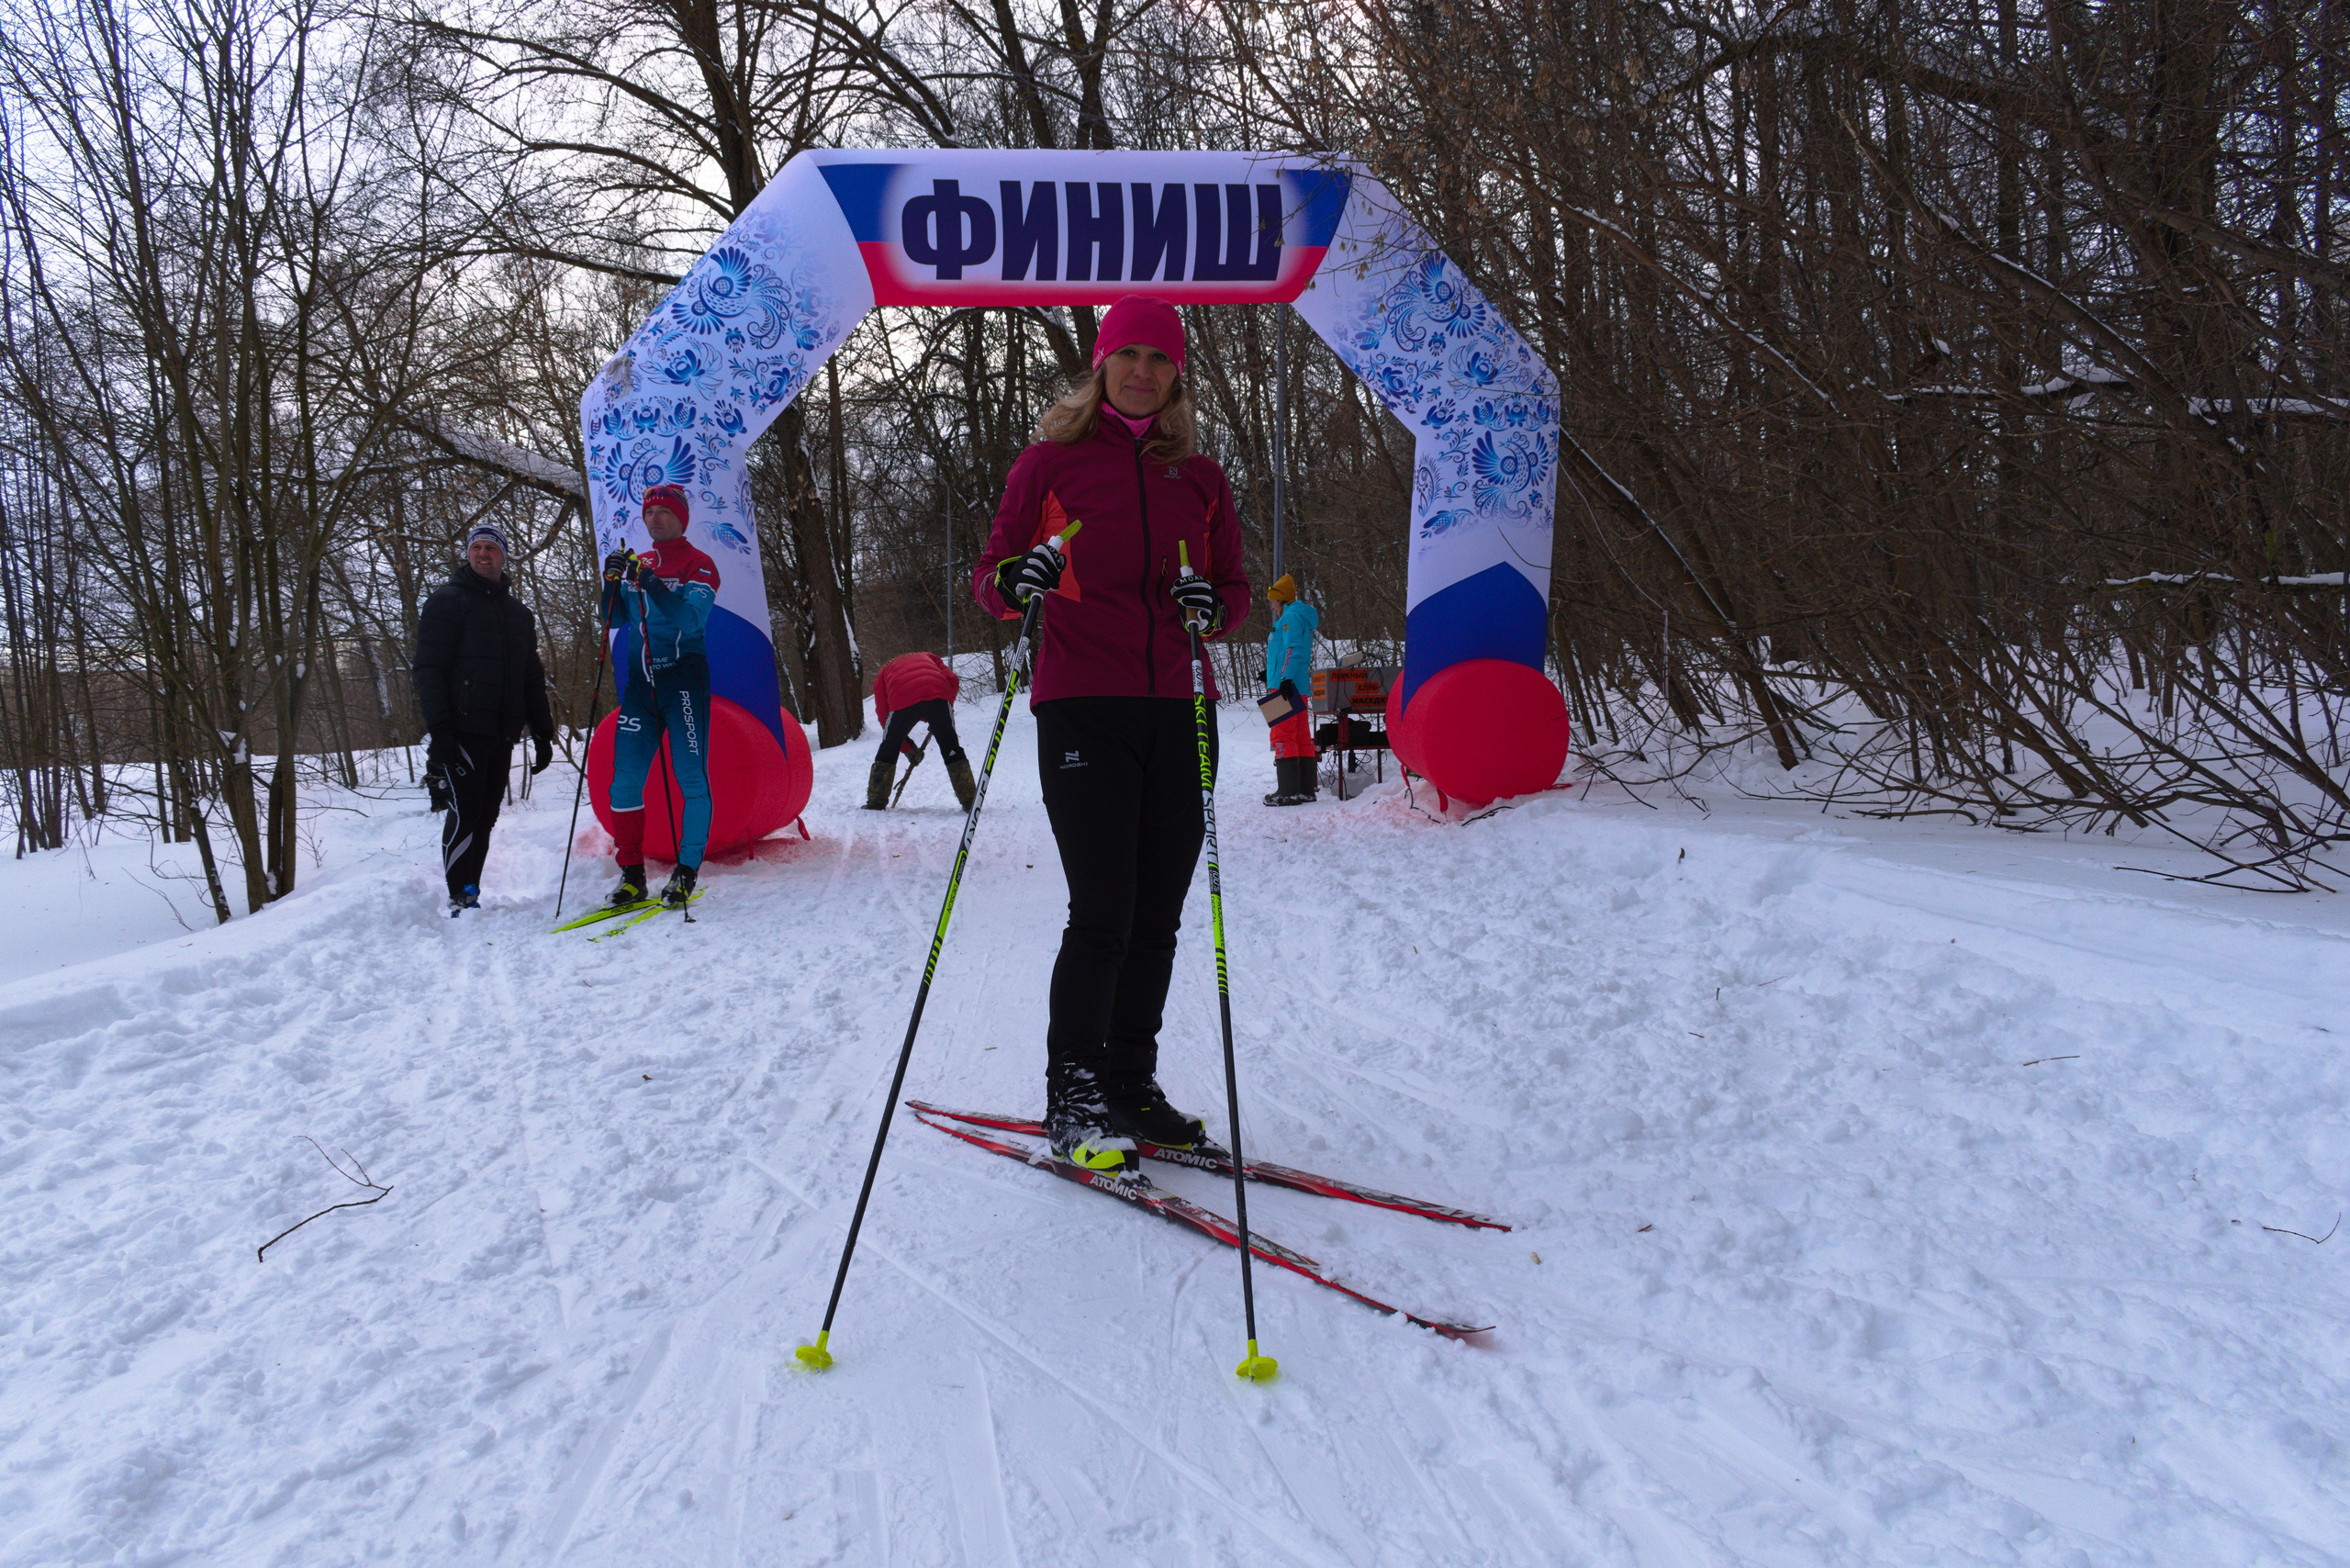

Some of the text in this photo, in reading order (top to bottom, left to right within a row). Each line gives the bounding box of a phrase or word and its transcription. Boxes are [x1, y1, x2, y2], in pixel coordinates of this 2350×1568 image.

[901, 178, 1283, 282] ФИНИШ
[678, 689, 699, 756] PROSPORT
[1059, 761, 1089, 770] NORDSKI
[1203, 797, 1219, 864] SPORT
[1152, 1148, 1219, 1170] ATOMIC
[1089, 1175, 1138, 1202] ATOMIC
